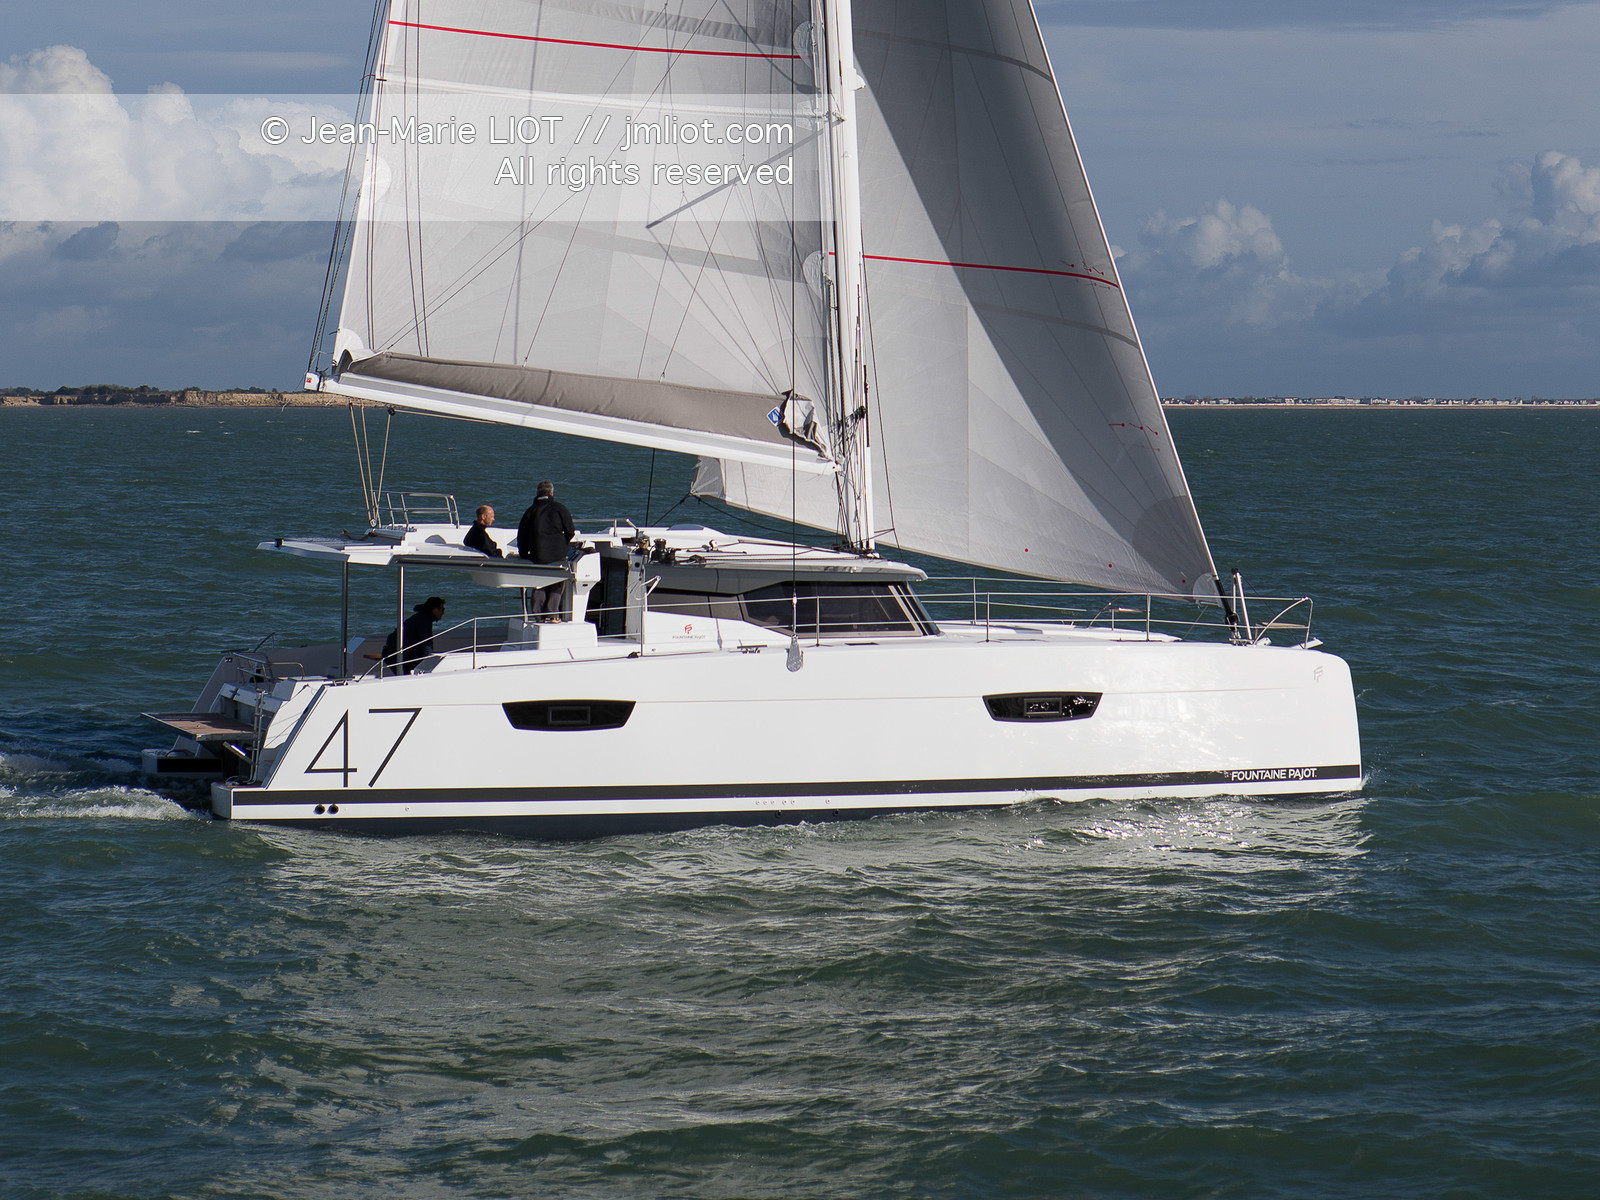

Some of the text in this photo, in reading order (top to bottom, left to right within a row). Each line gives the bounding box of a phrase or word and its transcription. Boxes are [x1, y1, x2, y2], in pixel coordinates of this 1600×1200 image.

[304, 707, 422, 788] 47
[1231, 767, 1317, 781] FOUNTAINE PAJOT
